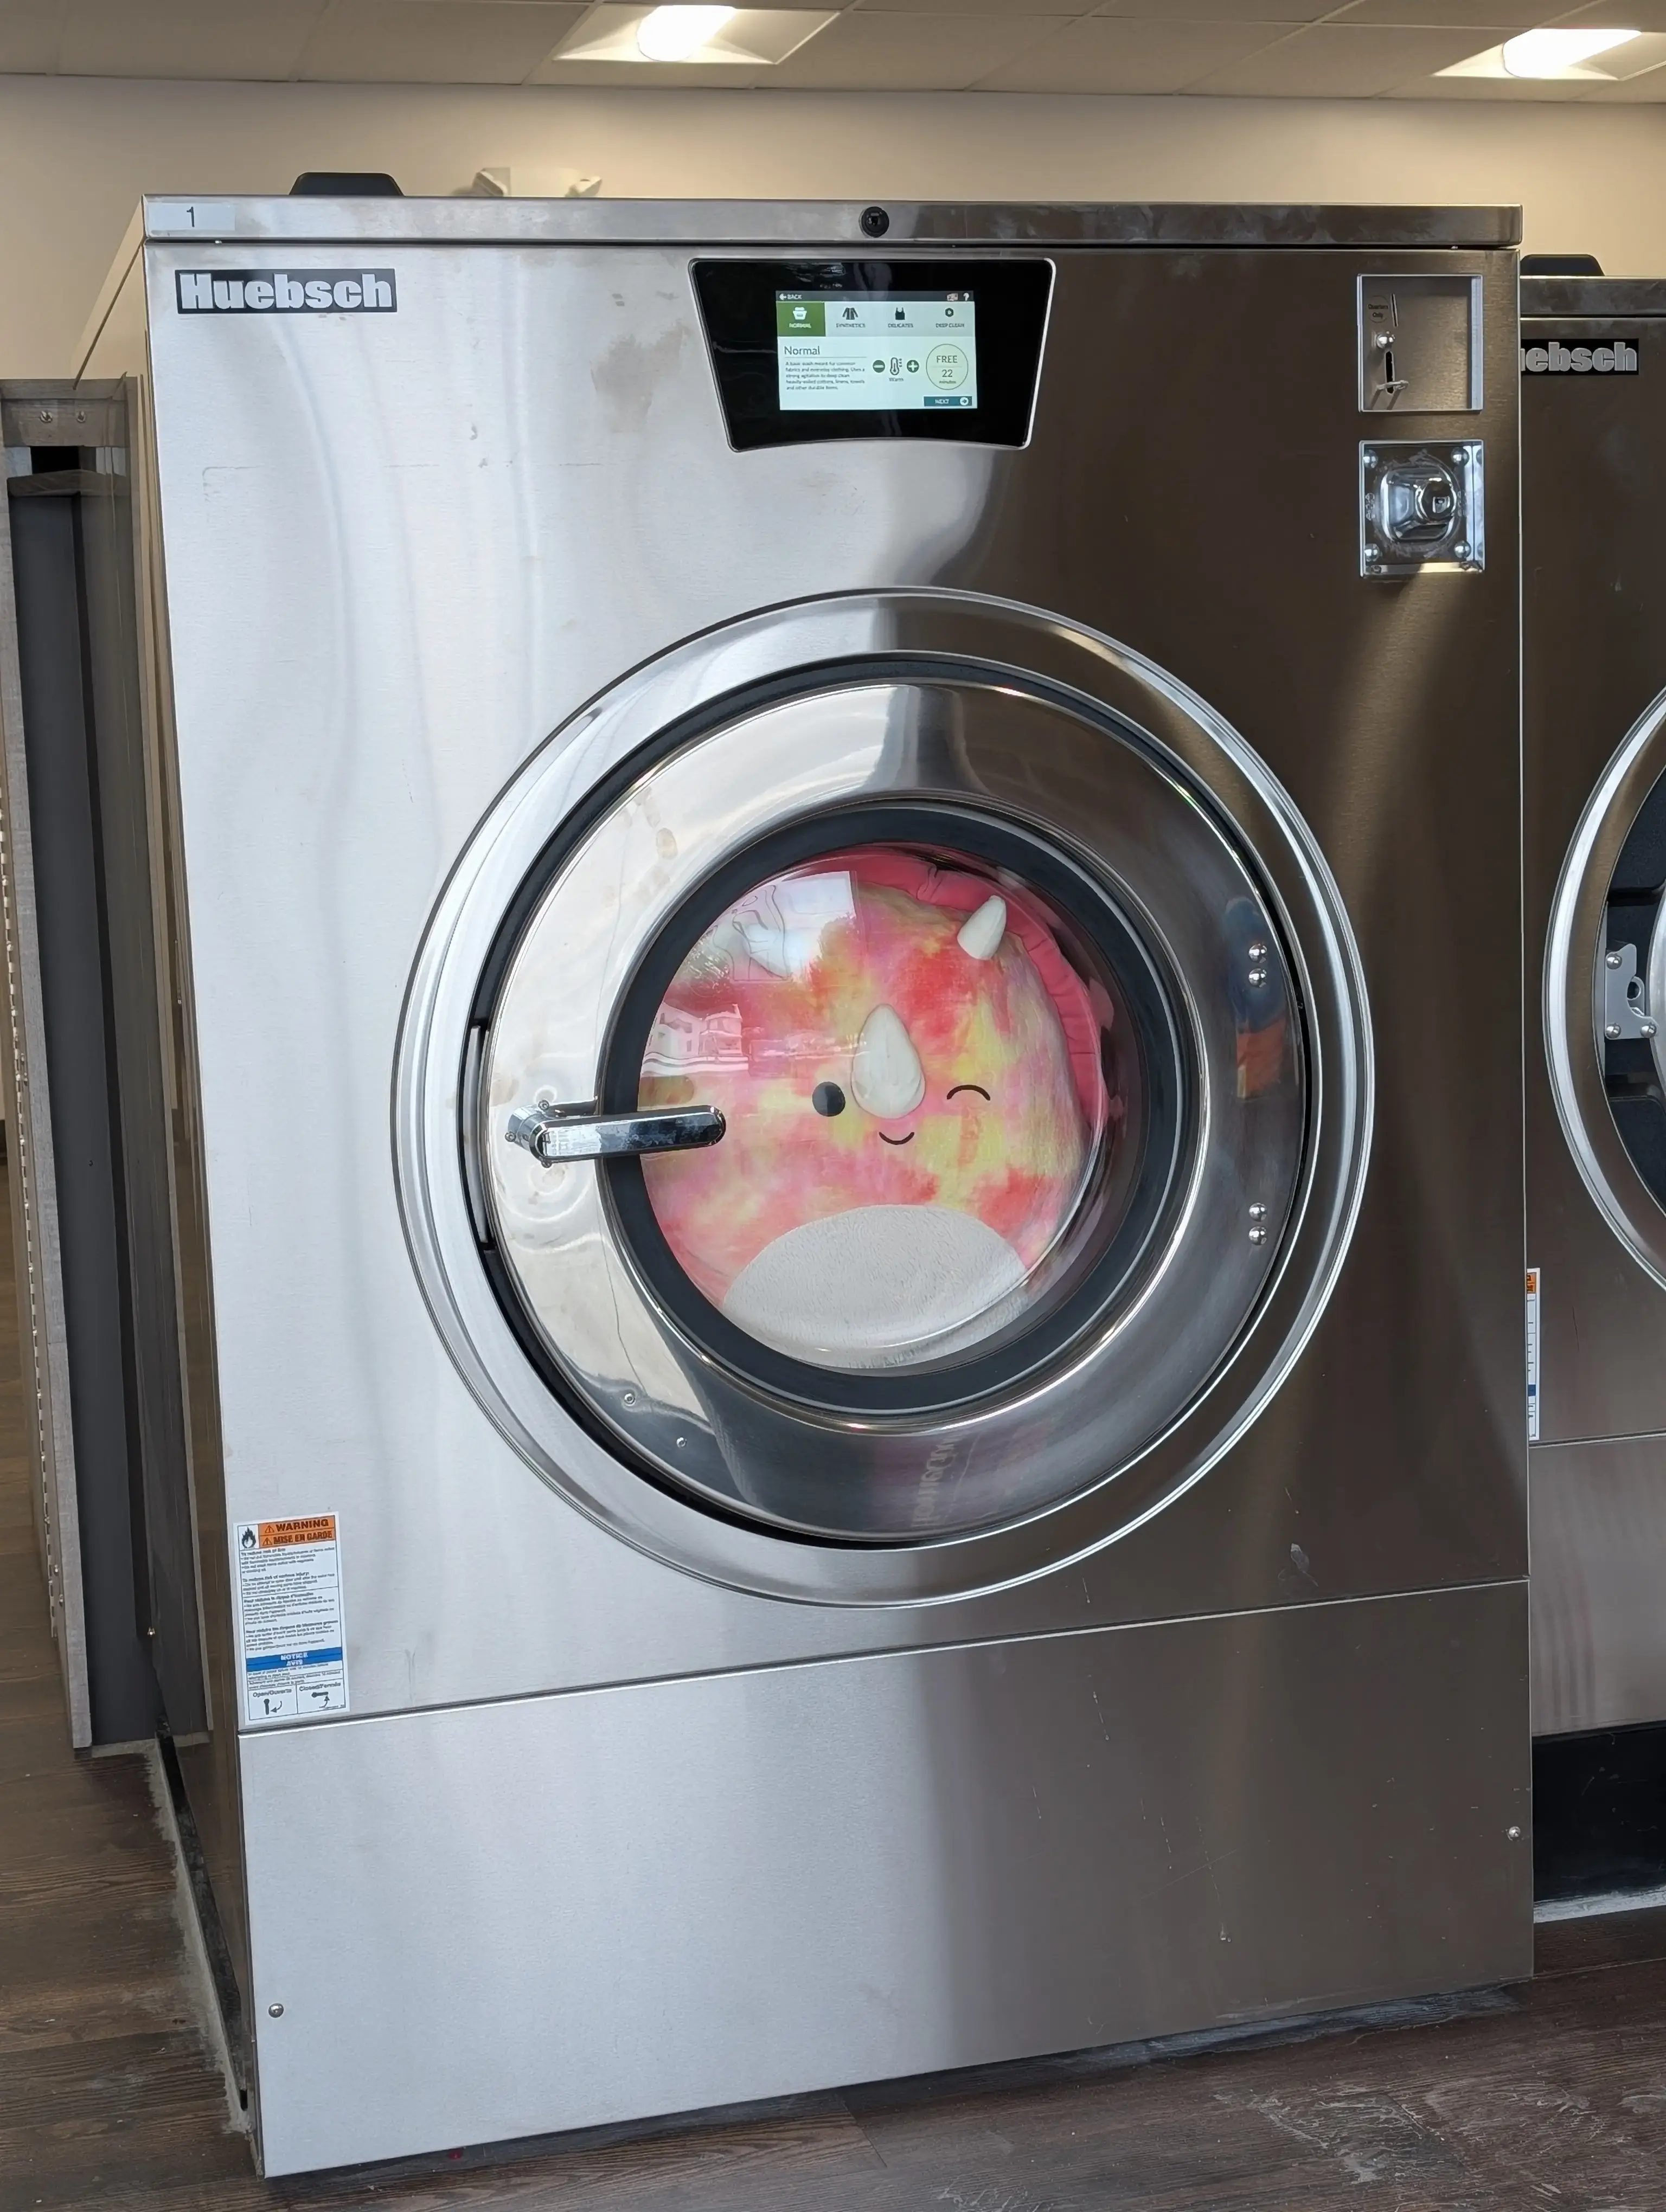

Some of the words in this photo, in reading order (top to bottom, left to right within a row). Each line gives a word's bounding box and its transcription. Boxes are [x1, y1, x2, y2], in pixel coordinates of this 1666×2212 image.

[186, 206, 195, 228] 1
[179, 273, 393, 310] Huebsch
[784, 346, 820, 355] Normal
[936, 355, 958, 363] FREE
[941, 369, 953, 377] 22
[275, 1519, 329, 1532] WARNING
[273, 1535, 293, 1545] MISE
[295, 1534, 305, 1542] EN
[307, 1530, 333, 1541] GARDE
[280, 1652, 309, 1661] NOTICE
